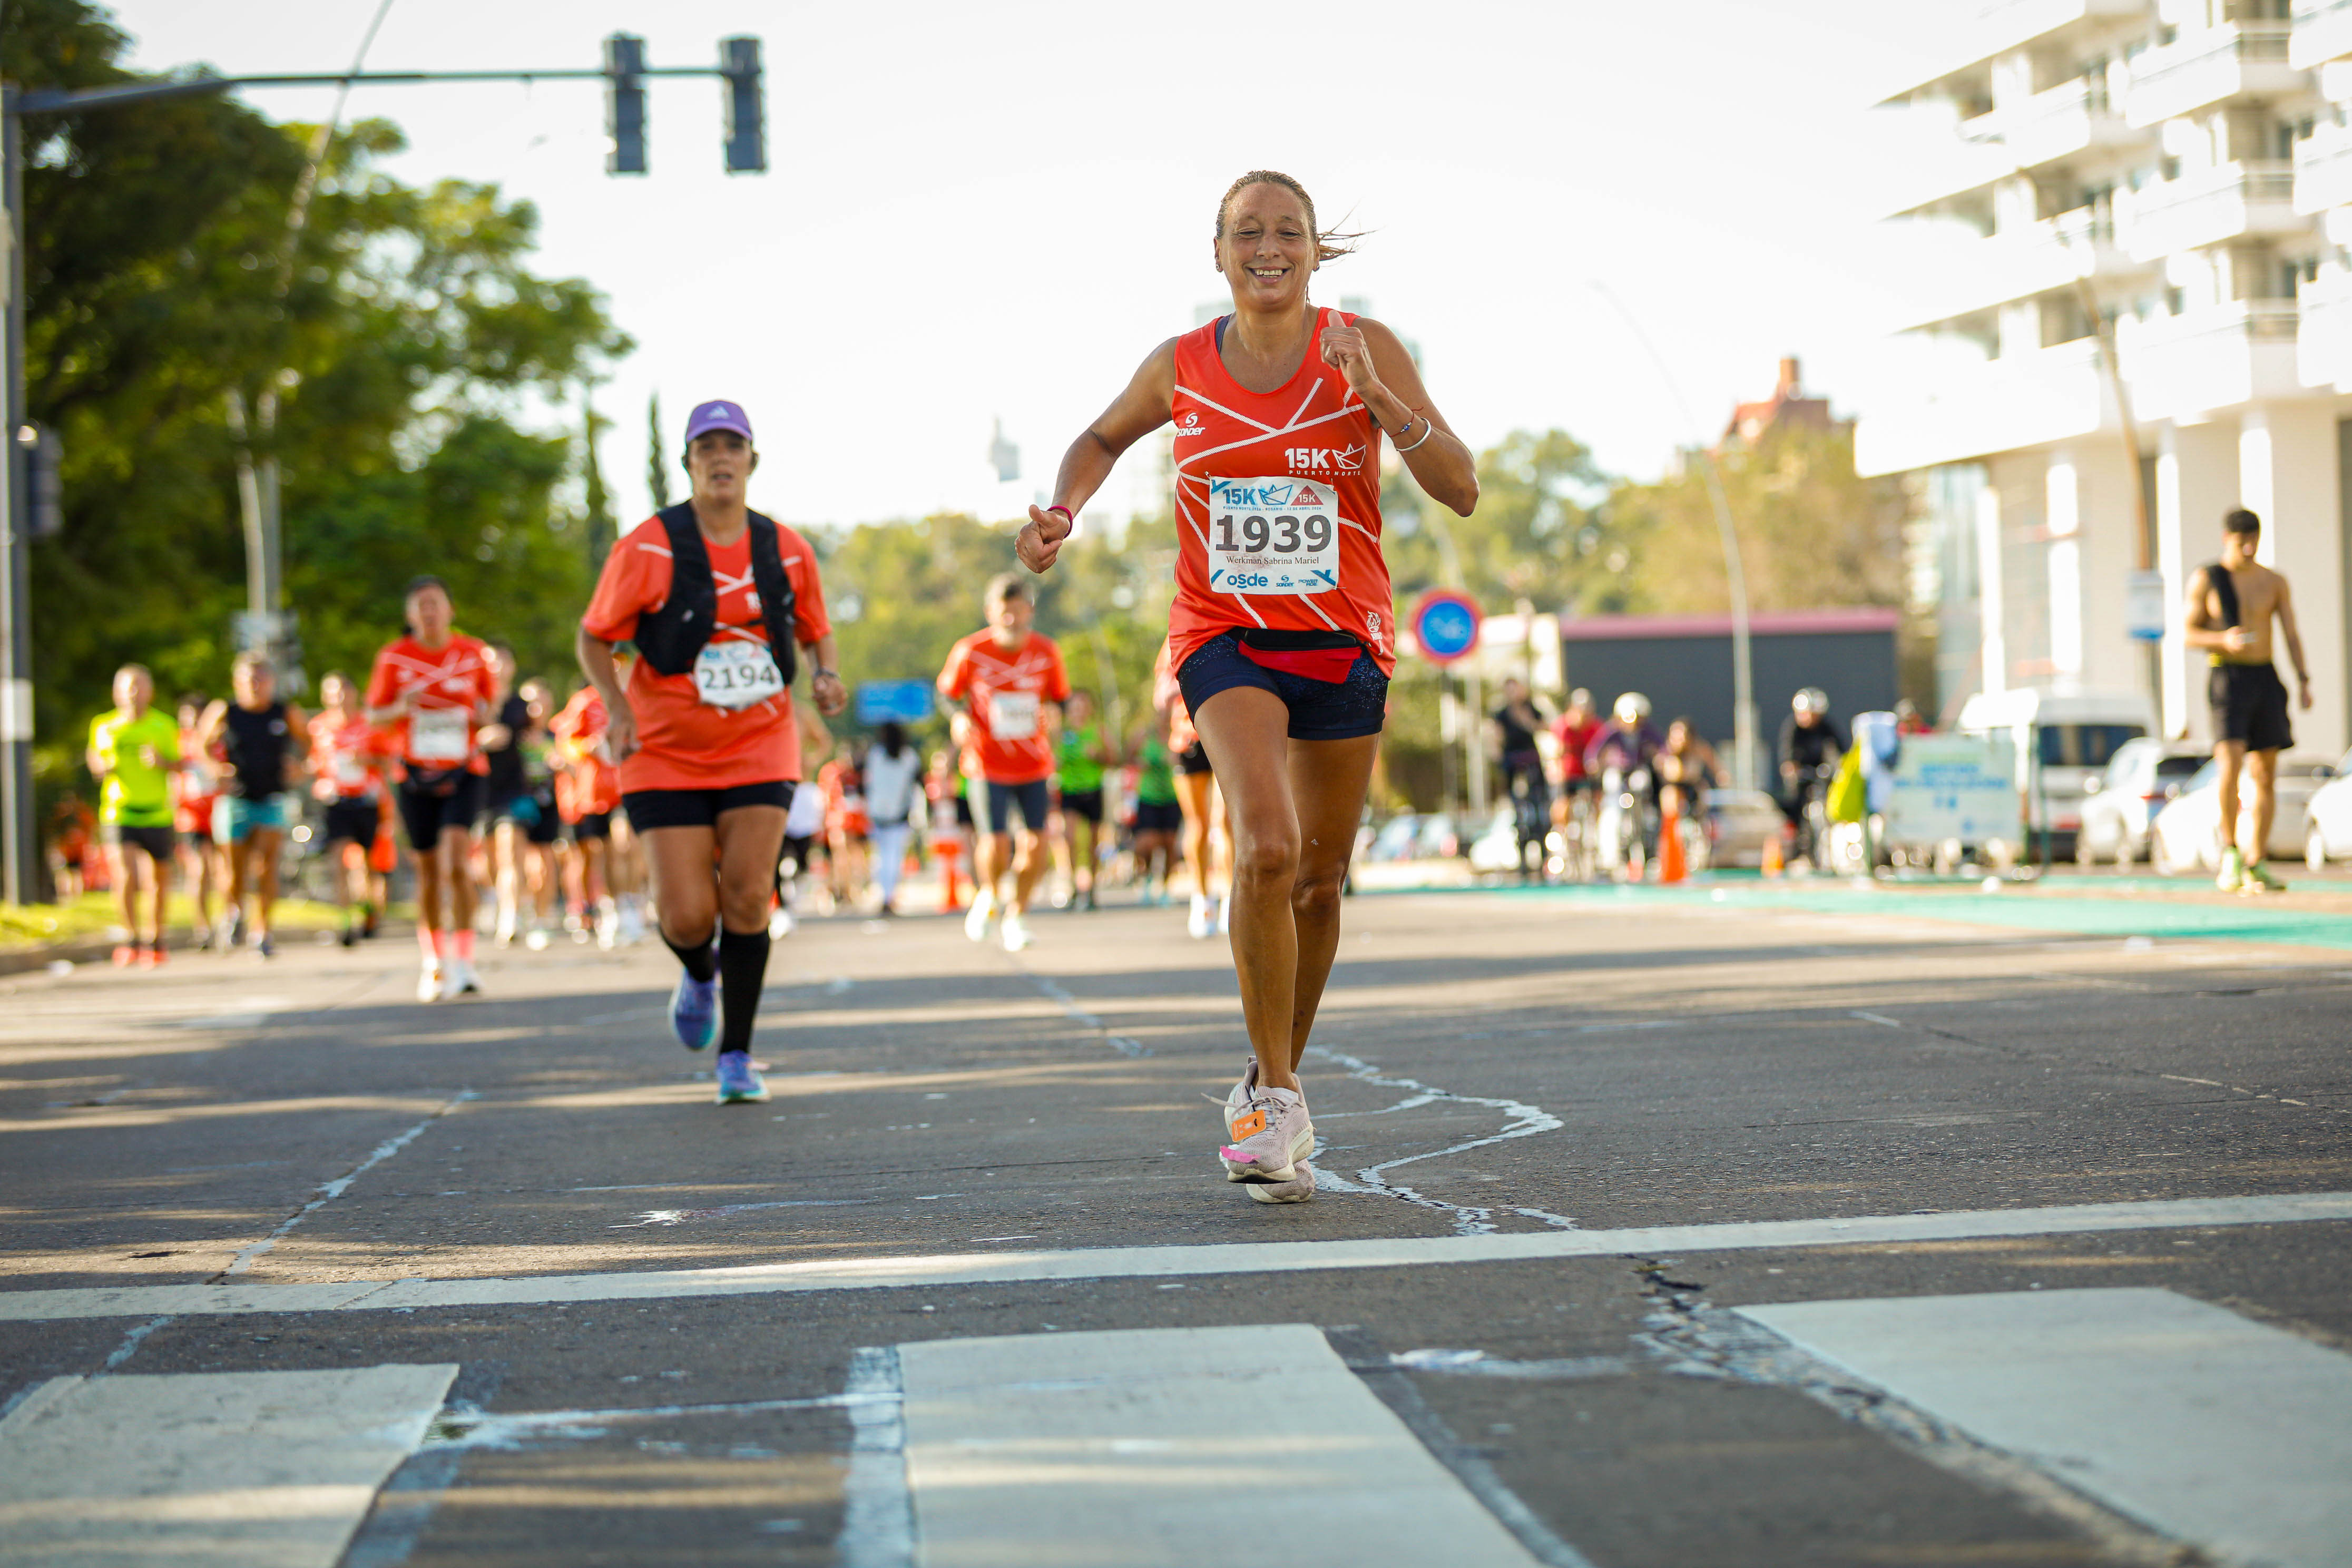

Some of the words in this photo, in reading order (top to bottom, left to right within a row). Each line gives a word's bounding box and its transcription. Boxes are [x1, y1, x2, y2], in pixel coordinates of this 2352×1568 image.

[1285, 448, 1330, 469] 15K
[1222, 488, 1256, 505] 15K
[1298, 494, 1316, 503] 15K
[1216, 515, 1331, 553] 1939
[1226, 556, 1261, 564] Werkman
[1227, 573, 1269, 589] osde
[700, 664, 777, 689] 2194
